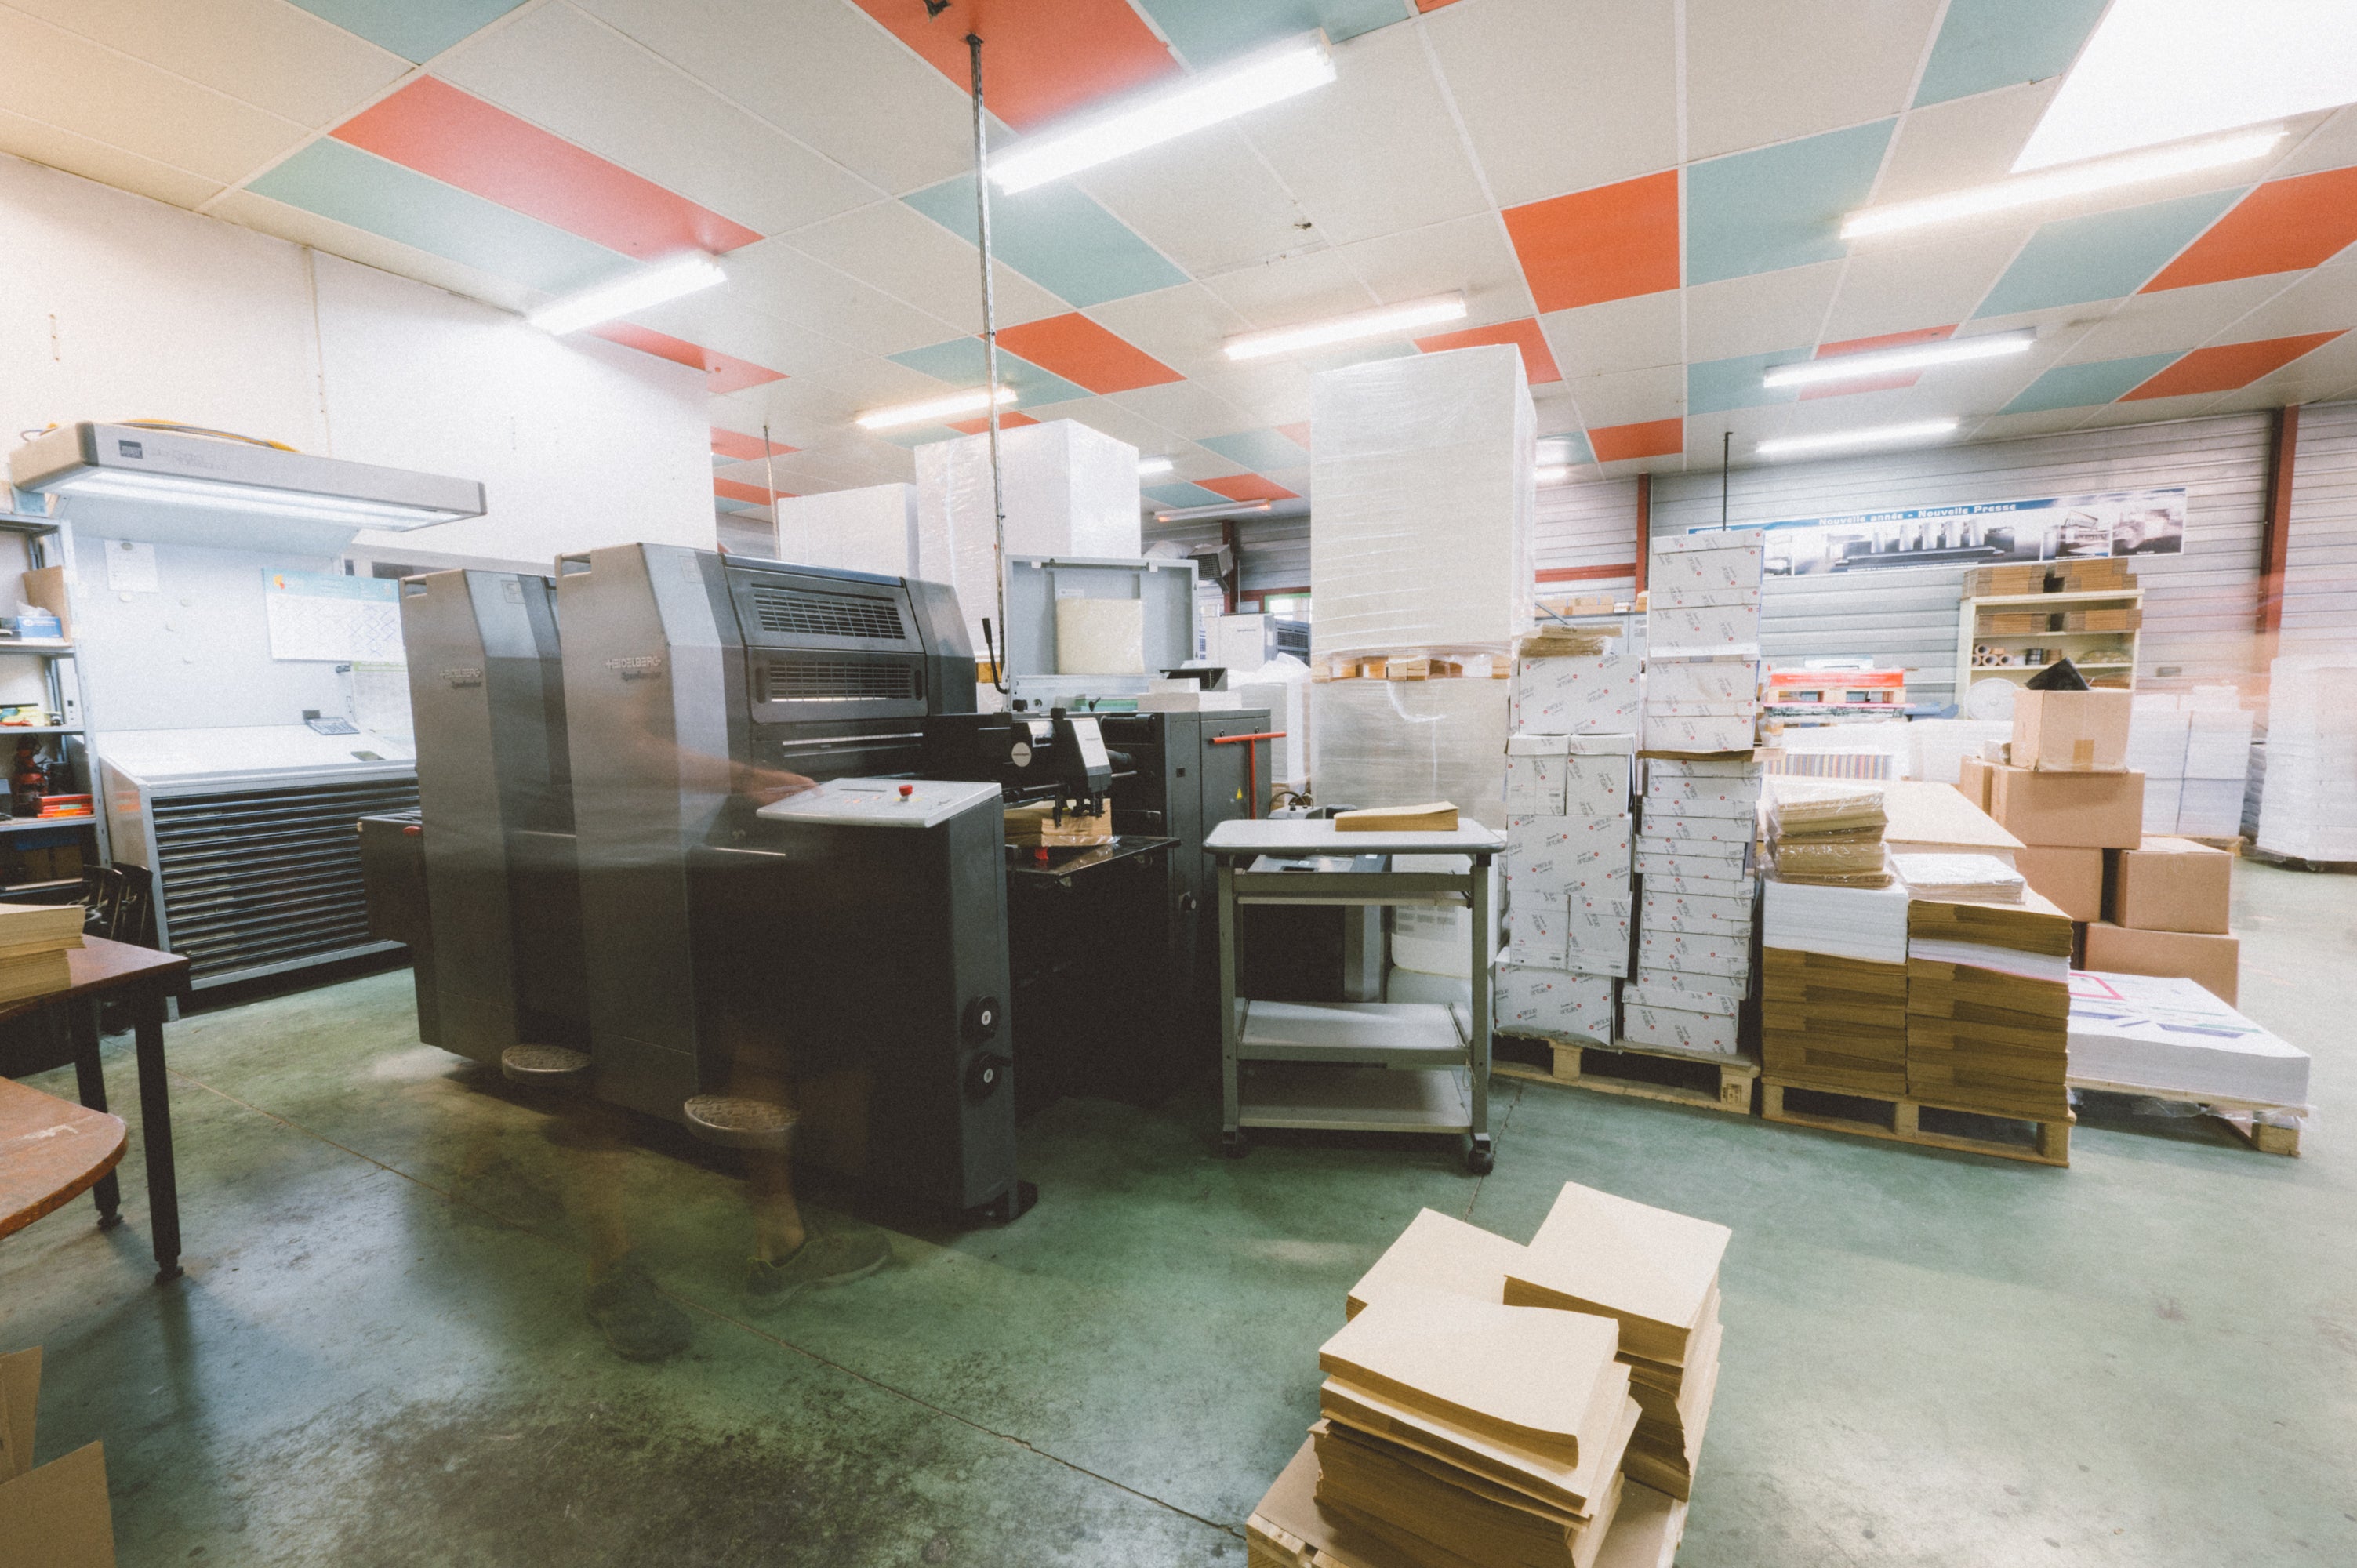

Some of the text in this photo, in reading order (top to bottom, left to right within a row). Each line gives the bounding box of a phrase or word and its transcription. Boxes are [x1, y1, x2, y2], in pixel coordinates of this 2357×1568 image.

[1819, 515, 1865, 525] Nouvelle
[1871, 512, 1903, 521] année
[1918, 507, 1968, 517] Nouvelle
[1974, 504, 2017, 514] Presse
[605, 656, 661, 670] HEIDELBERG
